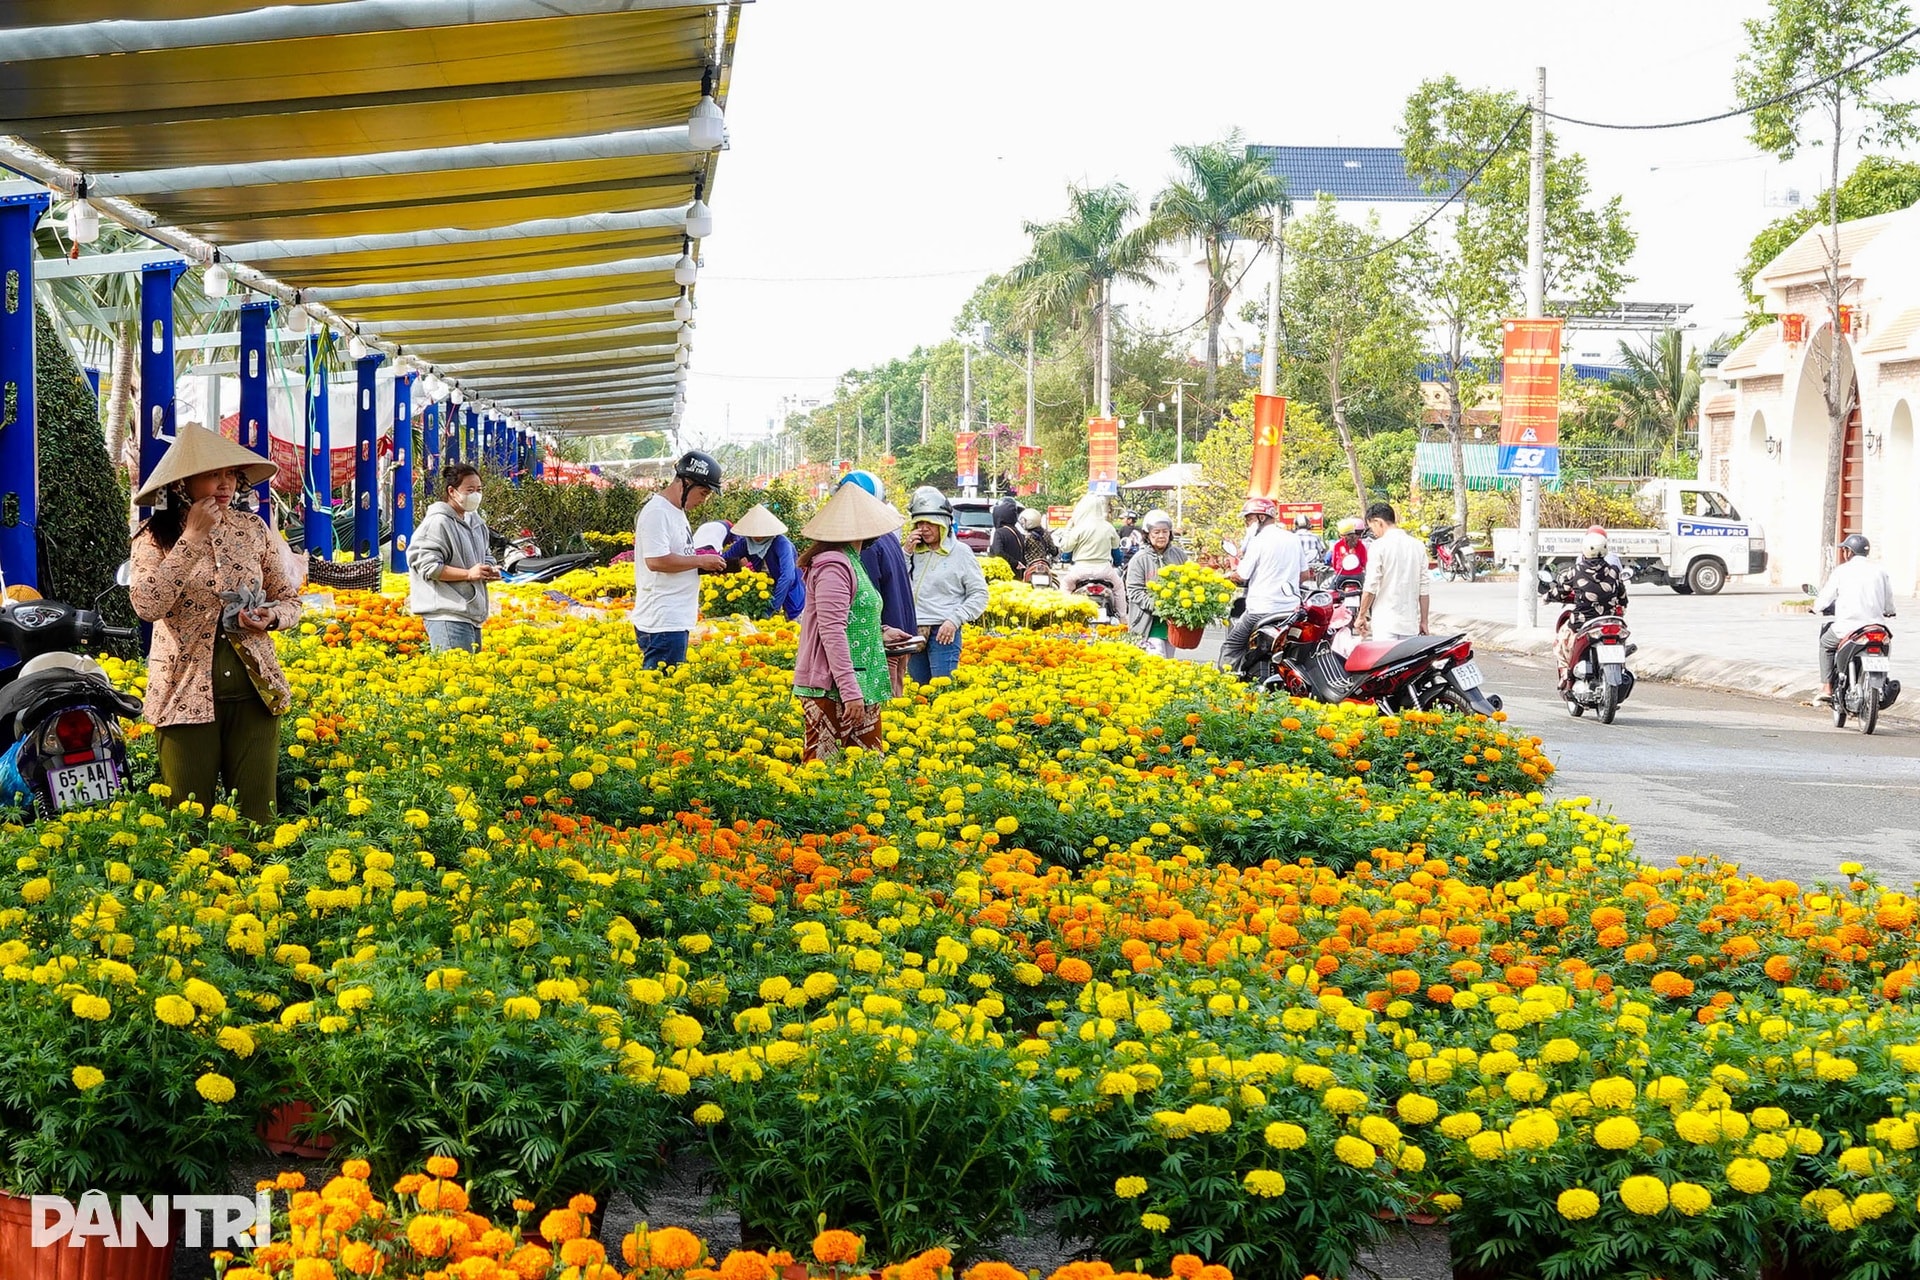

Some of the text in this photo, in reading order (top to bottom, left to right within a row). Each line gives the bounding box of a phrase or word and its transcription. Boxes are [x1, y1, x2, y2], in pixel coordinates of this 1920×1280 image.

[1514, 448, 1545, 467] 5G
[1693, 528, 1726, 536] CARRY
[59, 763, 105, 788] 65-AA
